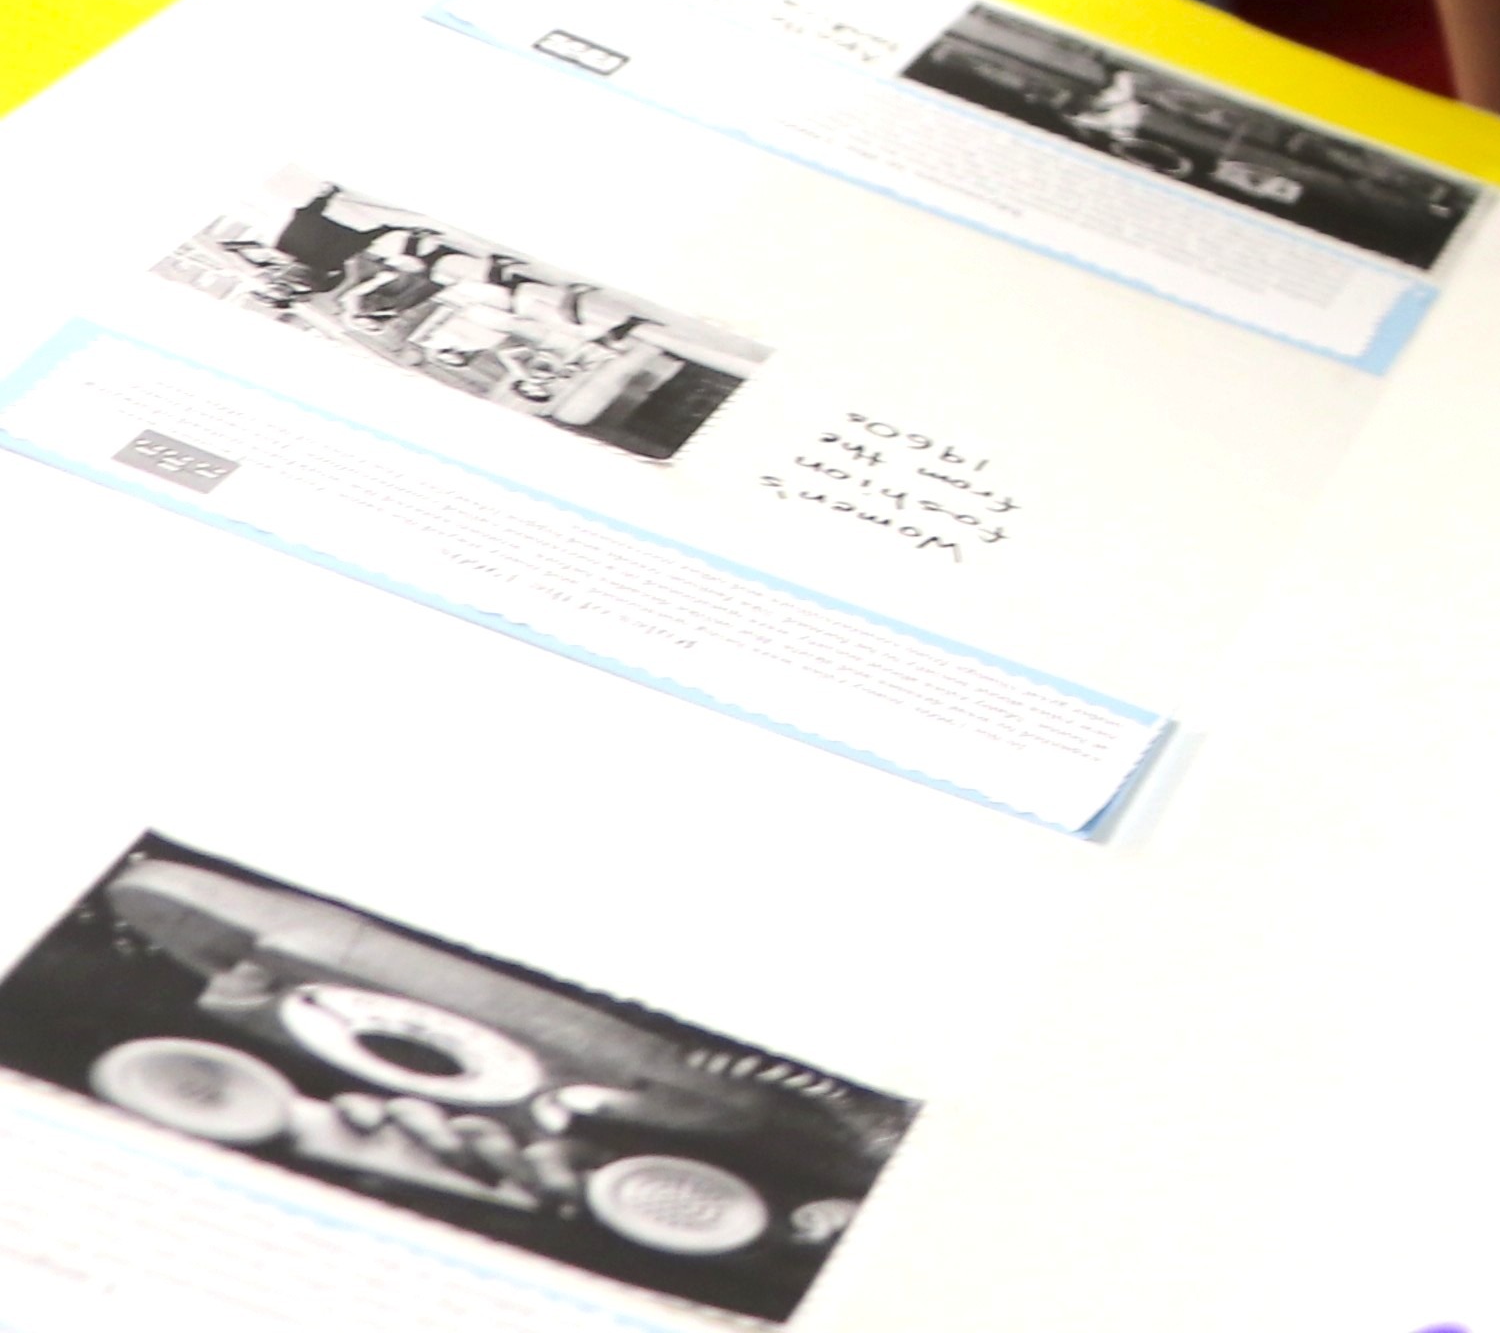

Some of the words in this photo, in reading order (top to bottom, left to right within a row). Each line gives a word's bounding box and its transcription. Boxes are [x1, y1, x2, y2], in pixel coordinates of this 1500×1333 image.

[819, 432, 885, 467] the
[846, 412, 989, 472] 1960s
[759, 475, 962, 564] Women's
[794, 456, 1009, 544] fashion
[917, 469, 1020, 513] from
